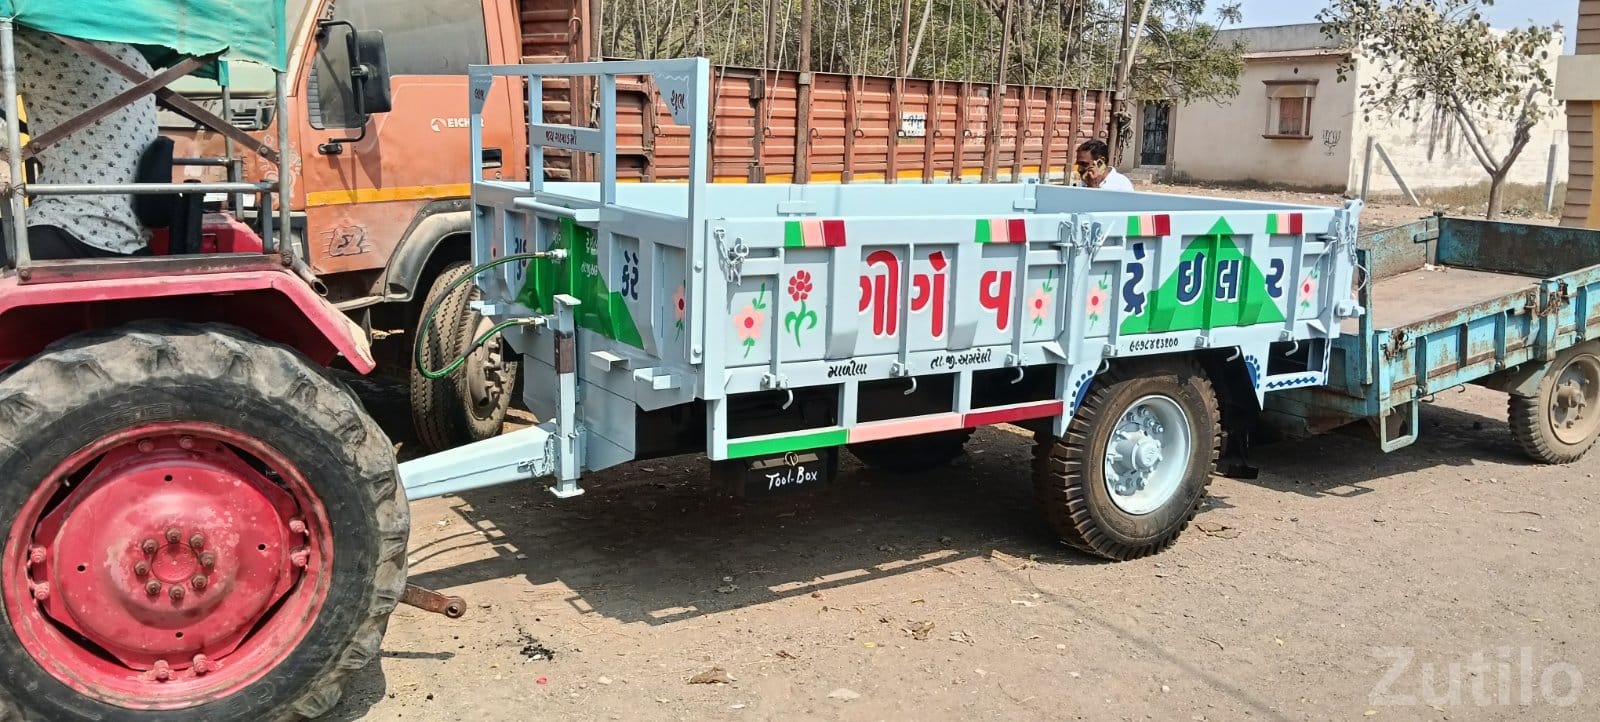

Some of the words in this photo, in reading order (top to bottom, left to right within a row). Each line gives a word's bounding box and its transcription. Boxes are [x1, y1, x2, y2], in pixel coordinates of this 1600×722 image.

[671, 90, 685, 116] શુભ
[447, 117, 485, 127] EICH
[765, 466, 818, 490] Tool-Box
